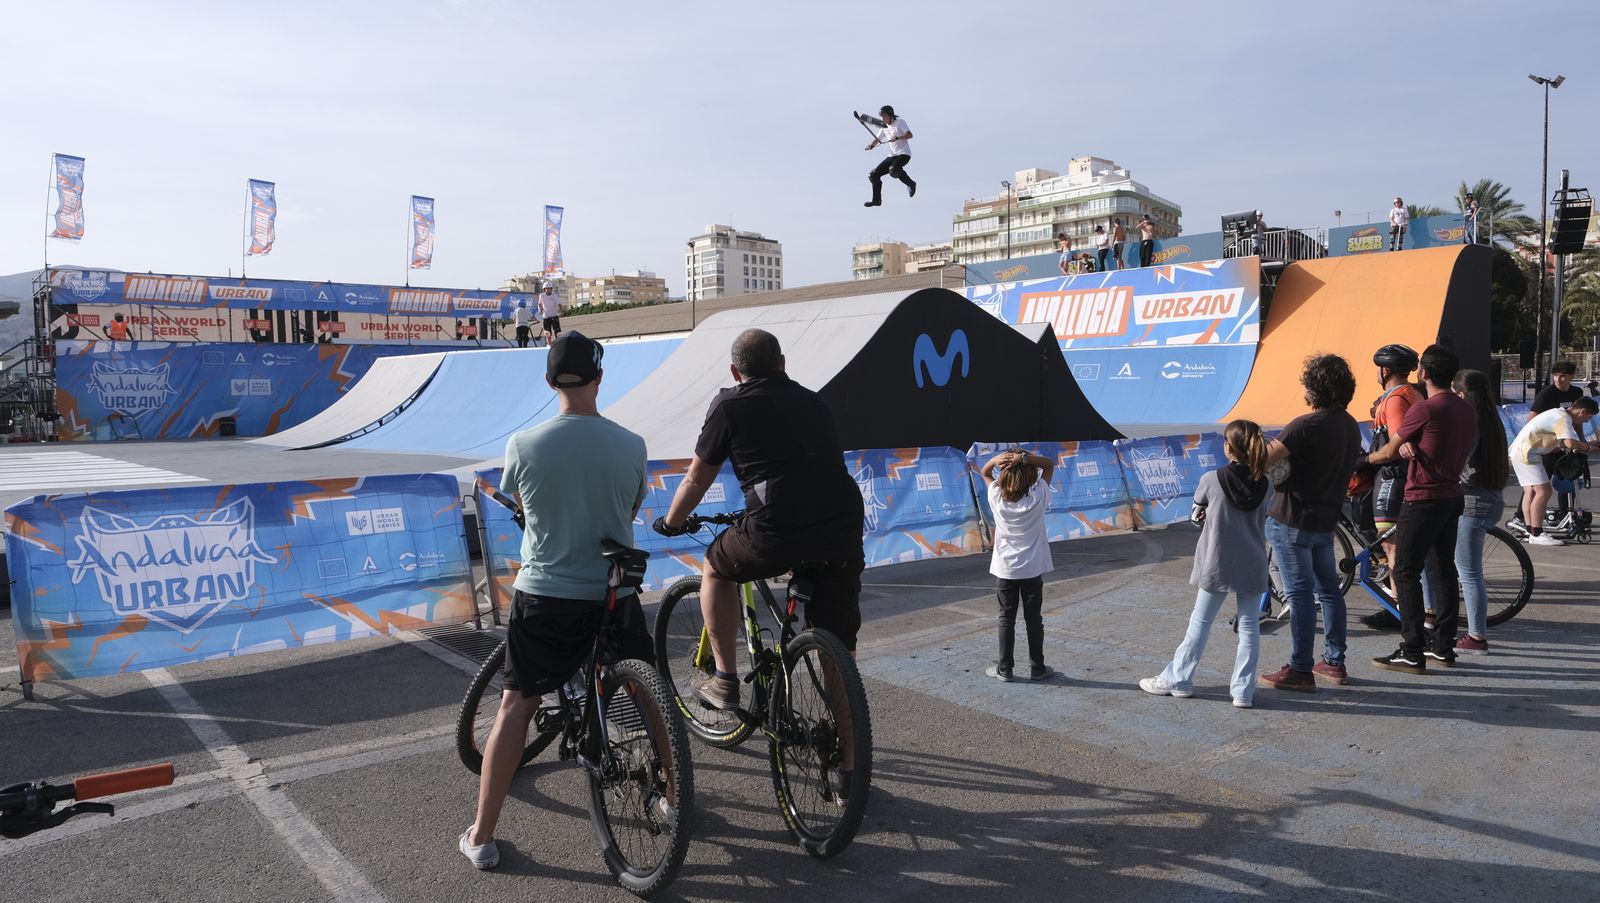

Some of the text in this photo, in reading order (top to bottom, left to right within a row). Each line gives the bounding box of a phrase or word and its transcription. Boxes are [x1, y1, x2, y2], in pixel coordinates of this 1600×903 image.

[216, 287, 268, 300] URBAN
[457, 299, 499, 310] URBAN
[1142, 293, 1235, 320] URBAN
[175, 316, 226, 327] WORLD
[361, 322, 443, 332] URBAN WORLD
[152, 326, 199, 337] SERIES
[88, 374, 177, 394] Andalucía
[104, 395, 162, 409] URBAN
[1146, 482, 1180, 498] URBAN
[71, 527, 276, 580] Andalucía
[114, 571, 247, 612] URBAN
